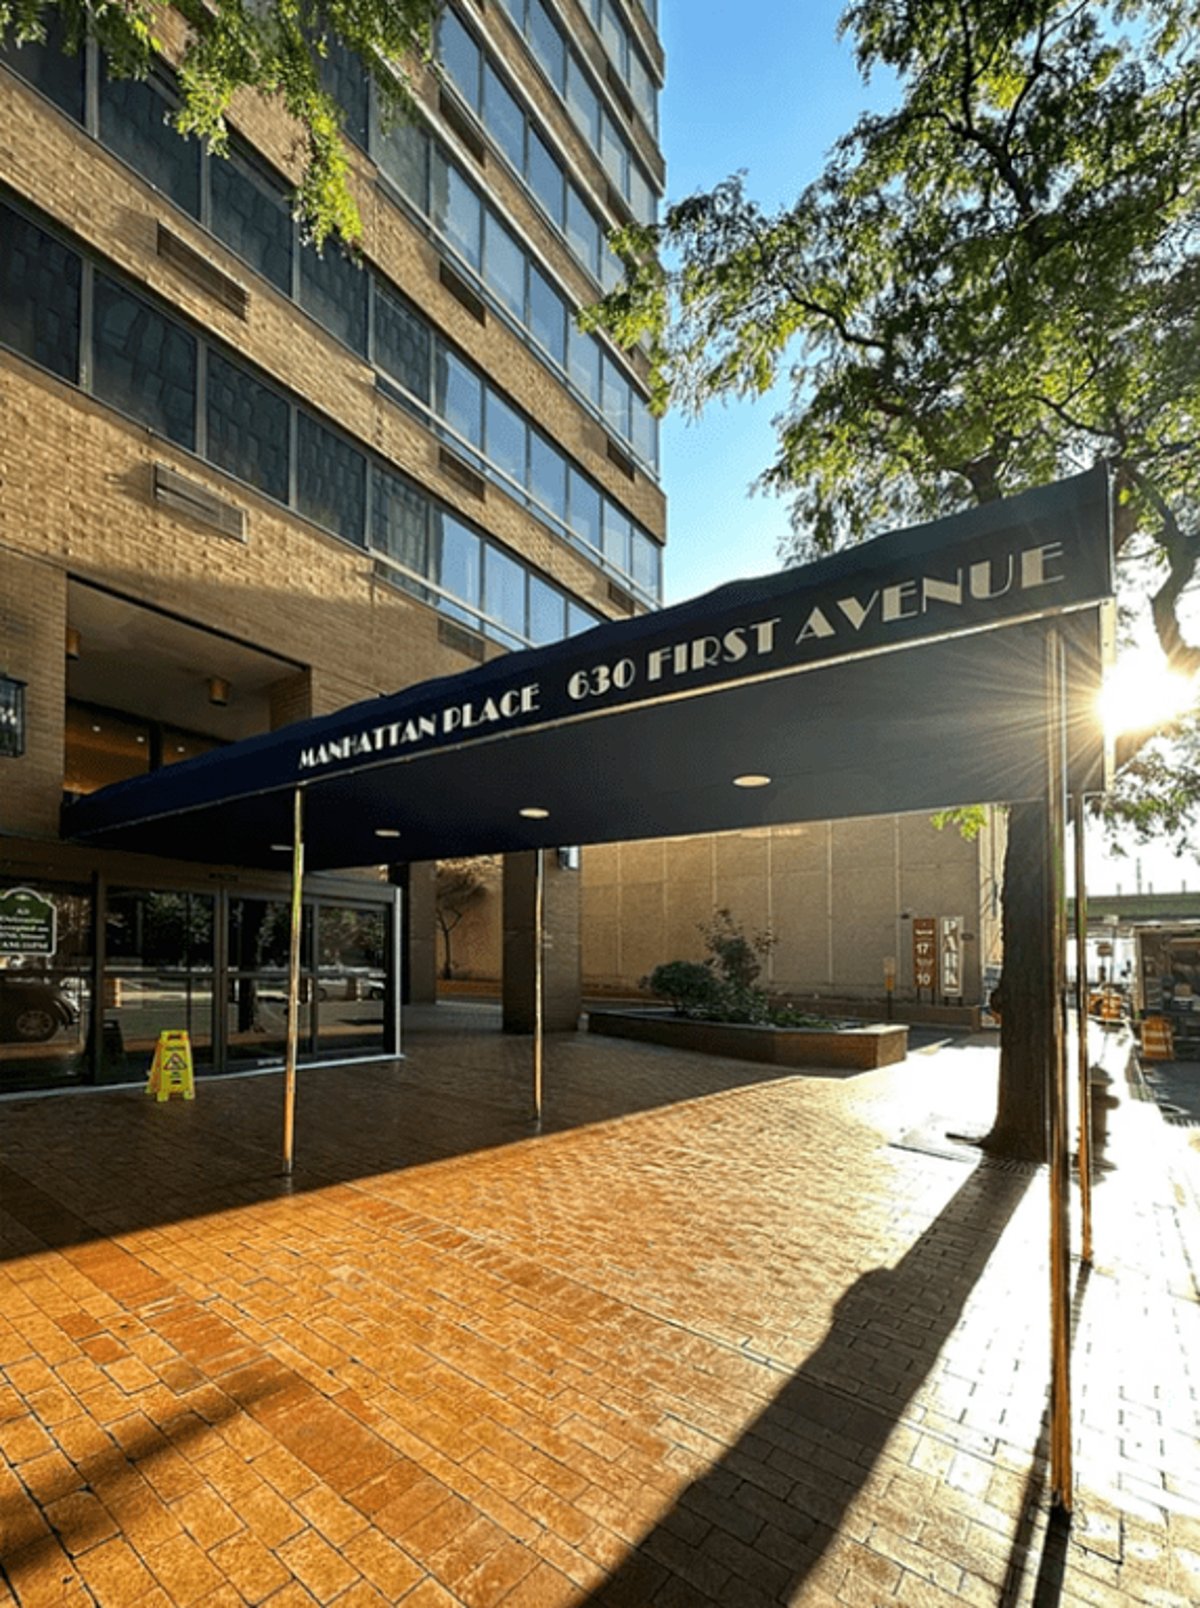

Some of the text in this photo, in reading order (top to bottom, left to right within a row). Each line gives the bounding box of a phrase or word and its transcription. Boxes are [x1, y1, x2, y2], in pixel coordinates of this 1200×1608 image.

[298, 541, 1065, 769] MANHATTAN PLACE 630 FIRST AVENUE
[944, 920, 958, 985] PARK
